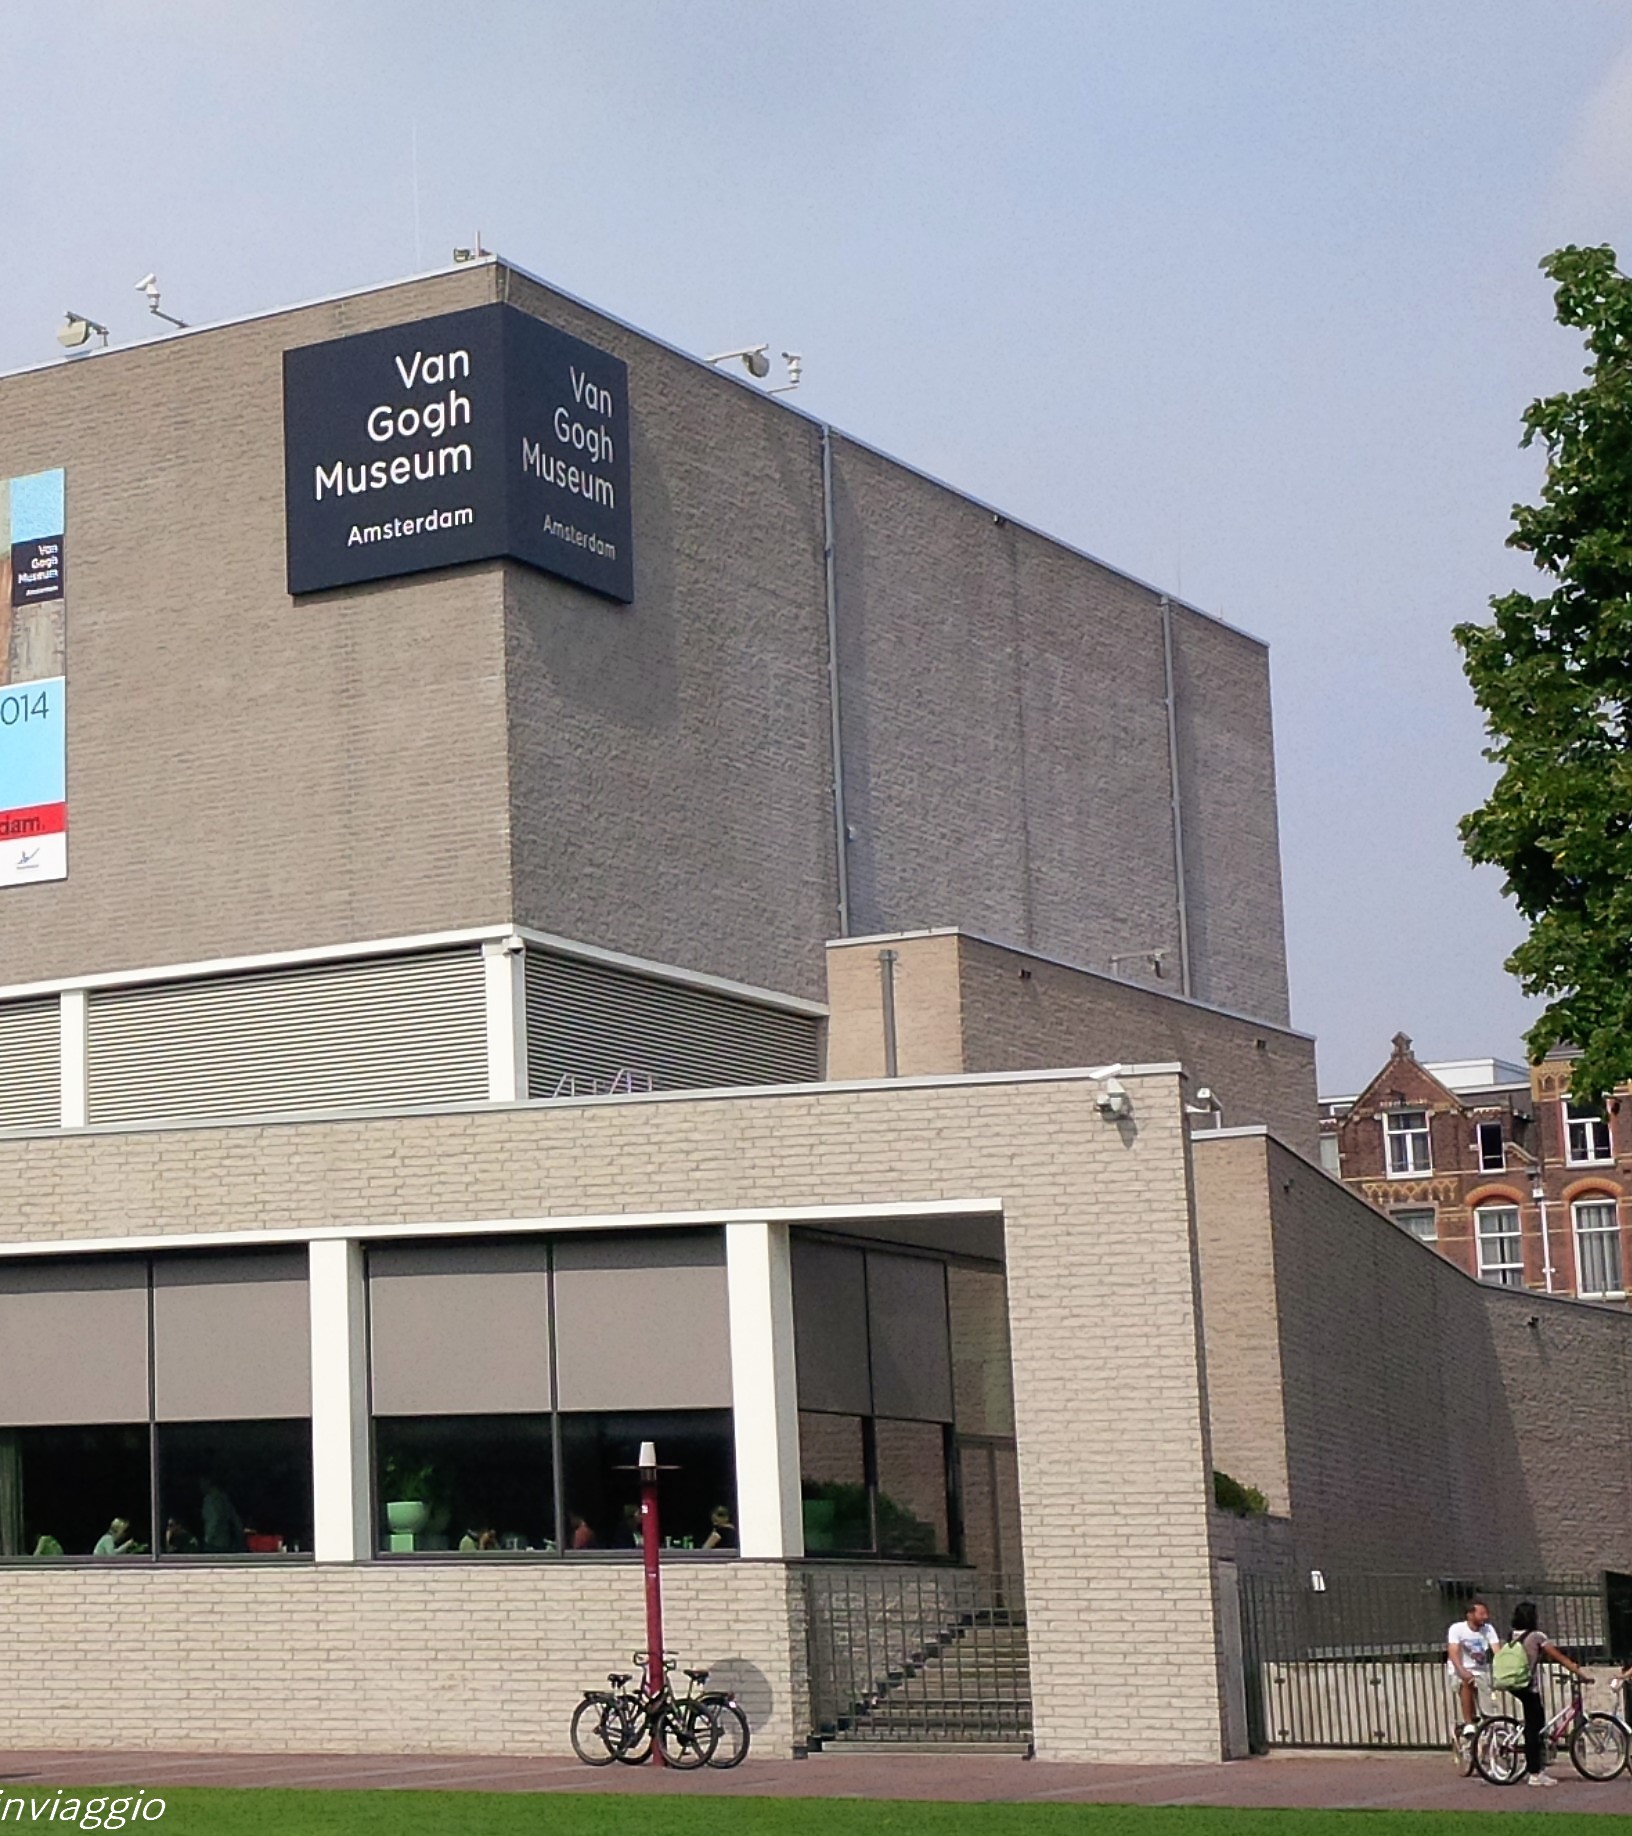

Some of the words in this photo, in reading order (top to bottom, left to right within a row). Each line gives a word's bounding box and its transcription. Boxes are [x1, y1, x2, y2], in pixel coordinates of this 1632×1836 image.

[395, 349, 470, 389] Van
[570, 364, 613, 419] Van
[367, 389, 471, 442] Gogh
[554, 406, 615, 464] Gogh
[314, 443, 472, 501] Museum
[521, 436, 616, 509] Museum
[346, 506, 474, 547] Amsterdam
[542, 513, 617, 561] Amsterdam
